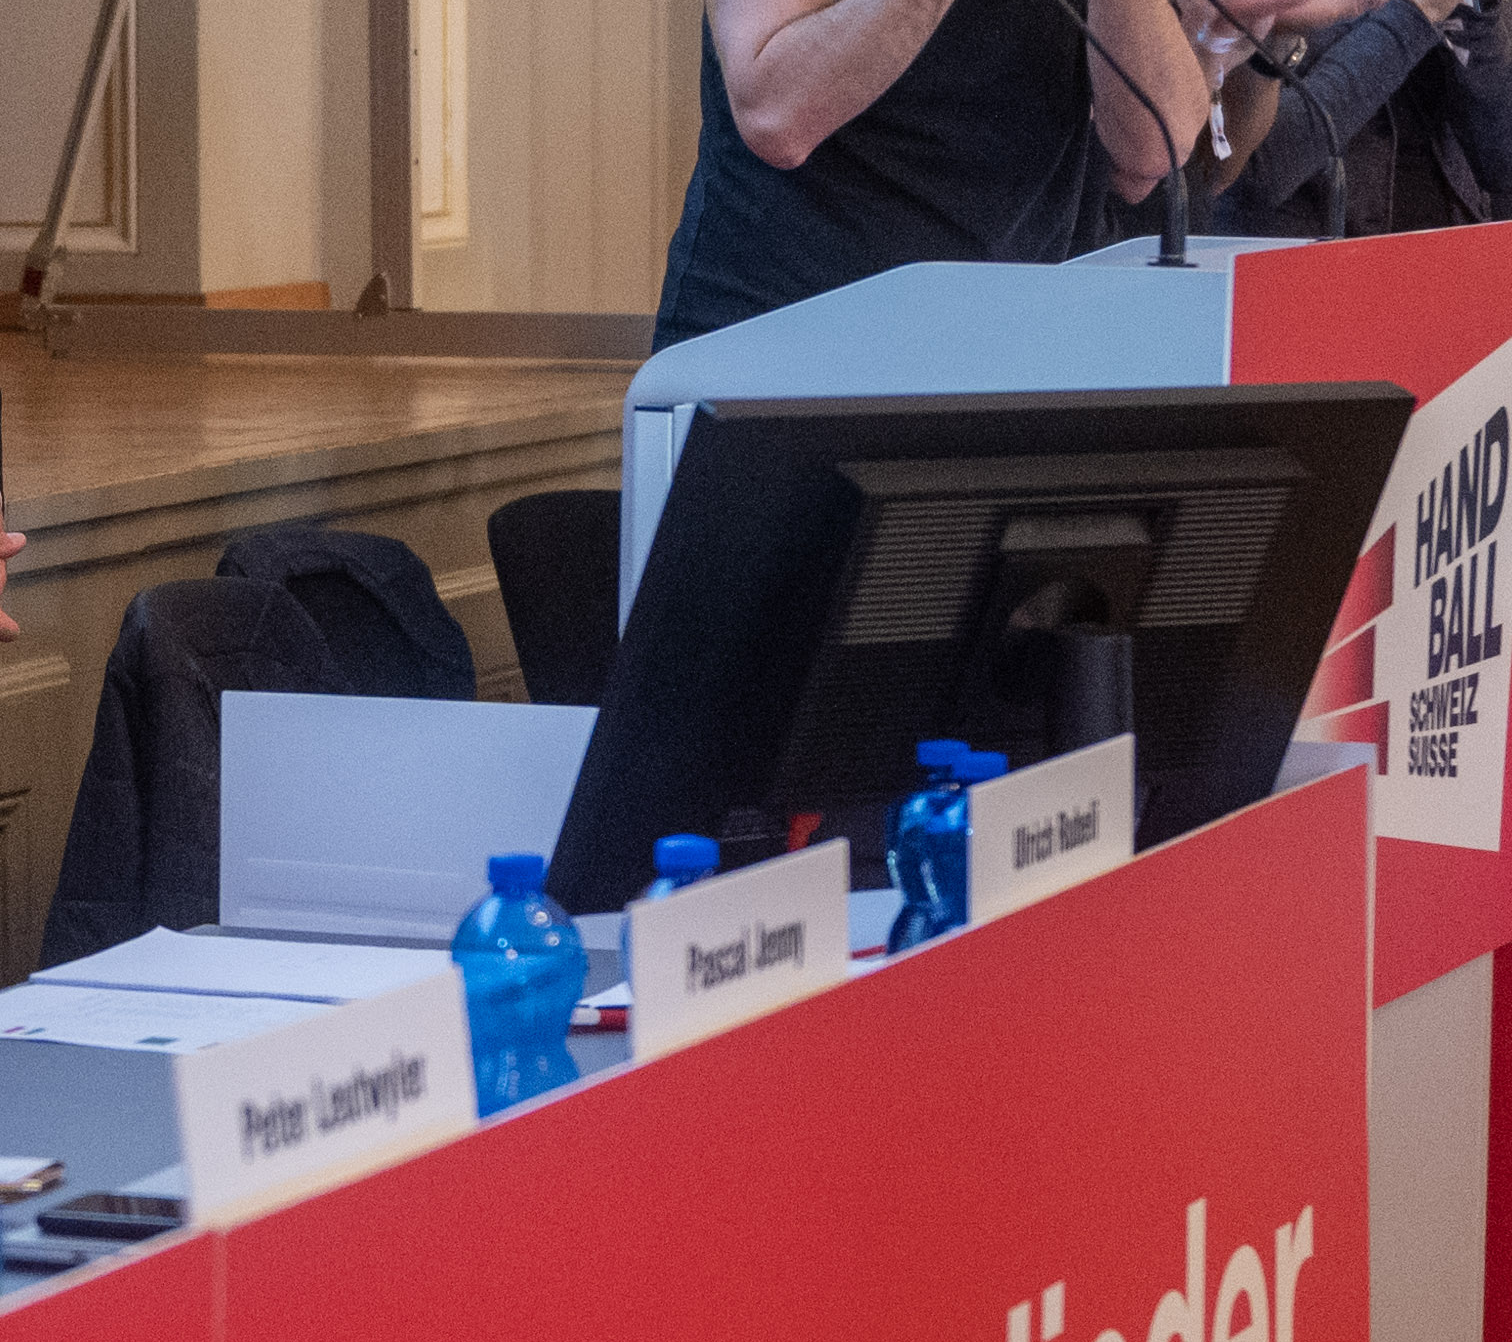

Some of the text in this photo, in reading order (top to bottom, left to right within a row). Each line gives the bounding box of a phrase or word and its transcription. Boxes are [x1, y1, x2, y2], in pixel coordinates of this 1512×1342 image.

[1414, 406, 1510, 589] HAND
[1428, 540, 1503, 680] BALL
[1409, 672, 1479, 732] SCHWEIZ
[1408, 732, 1459, 778] SUISSE
[686, 920, 805, 994] Pascal Jenny
[241, 1094, 308, 1164] Peter
